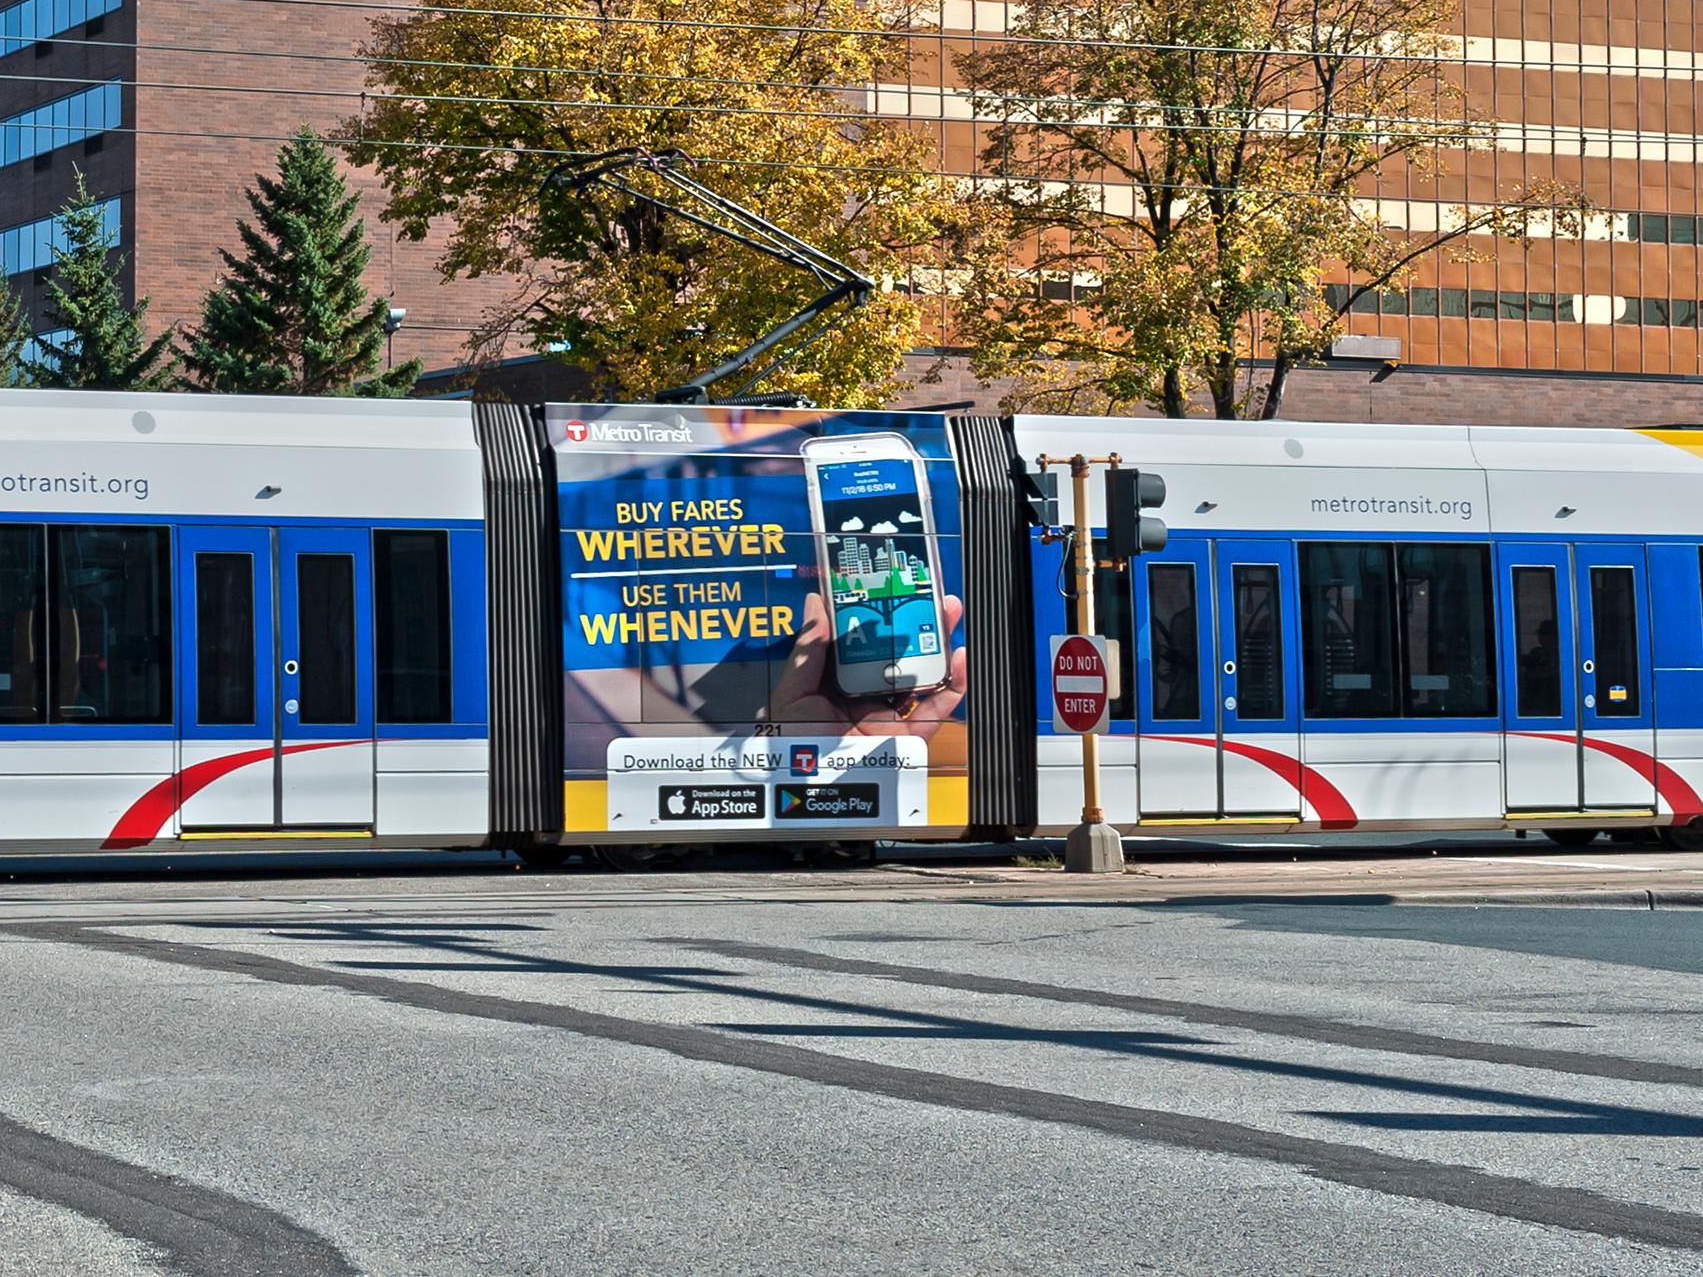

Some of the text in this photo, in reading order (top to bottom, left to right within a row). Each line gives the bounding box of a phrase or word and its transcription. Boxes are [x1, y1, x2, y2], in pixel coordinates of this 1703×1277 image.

[616, 498, 744, 524] BUY FARES
[1311, 496, 1472, 520] metrotransit.org
[576, 523, 786, 562] WHEREVER
[622, 581, 742, 607] USE THEM
[579, 605, 795, 645] WHENEVER
[845, 616, 868, 645] A
[1059, 656, 1097, 670] DO NOT
[1064, 698, 1096, 713] ENTER
[754, 724, 782, 737] 221
[623, 753, 704, 769] Download
[711, 753, 737, 768] the
[743, 753, 783, 768] NEW
[827, 755, 856, 771] app
[861, 752, 911, 771] today:
[692, 789, 726, 798] Download
[742, 789, 756, 798] the
[805, 788, 820, 796] GET
[691, 799, 757, 816] App Store
[806, 797, 873, 814] Google Play
